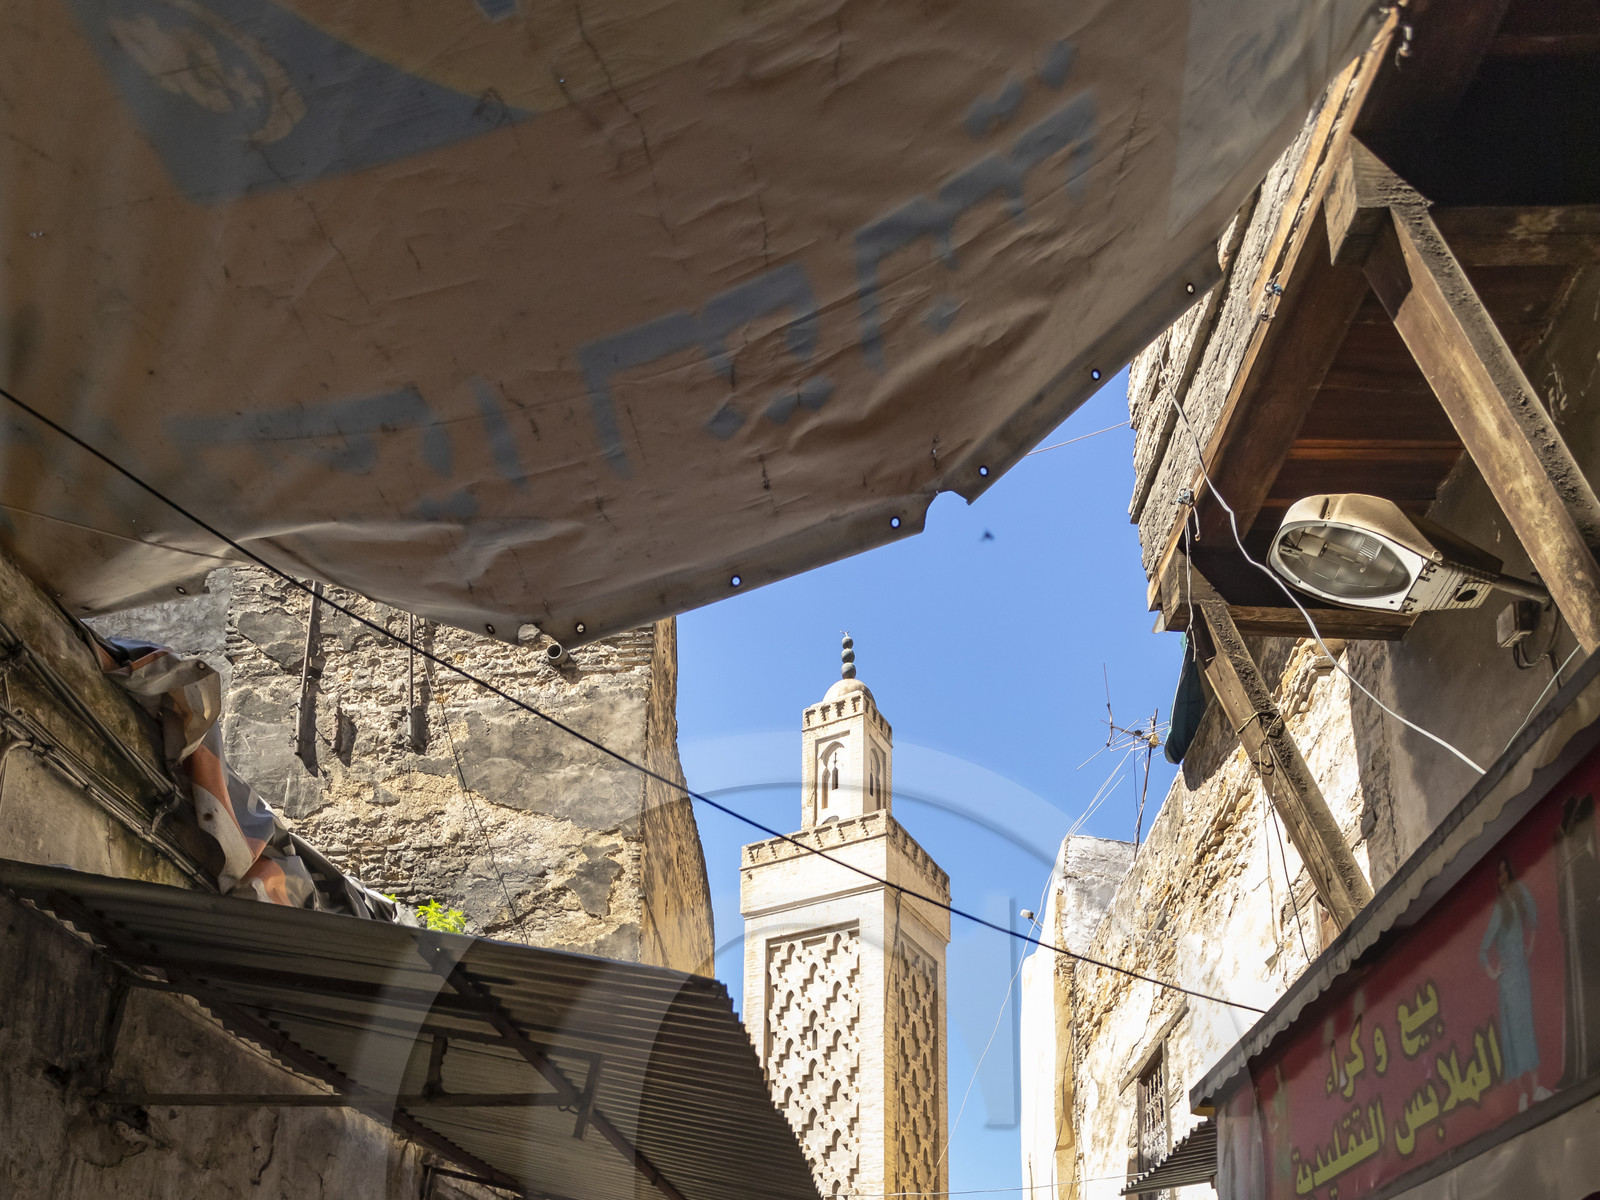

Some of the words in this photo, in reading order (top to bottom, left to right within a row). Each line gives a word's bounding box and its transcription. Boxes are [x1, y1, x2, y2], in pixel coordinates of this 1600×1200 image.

[1374, 1027, 1387, 1073] و
[1398, 984, 1441, 1056] بيع
[1395, 1023, 1501, 1155] الملابس
